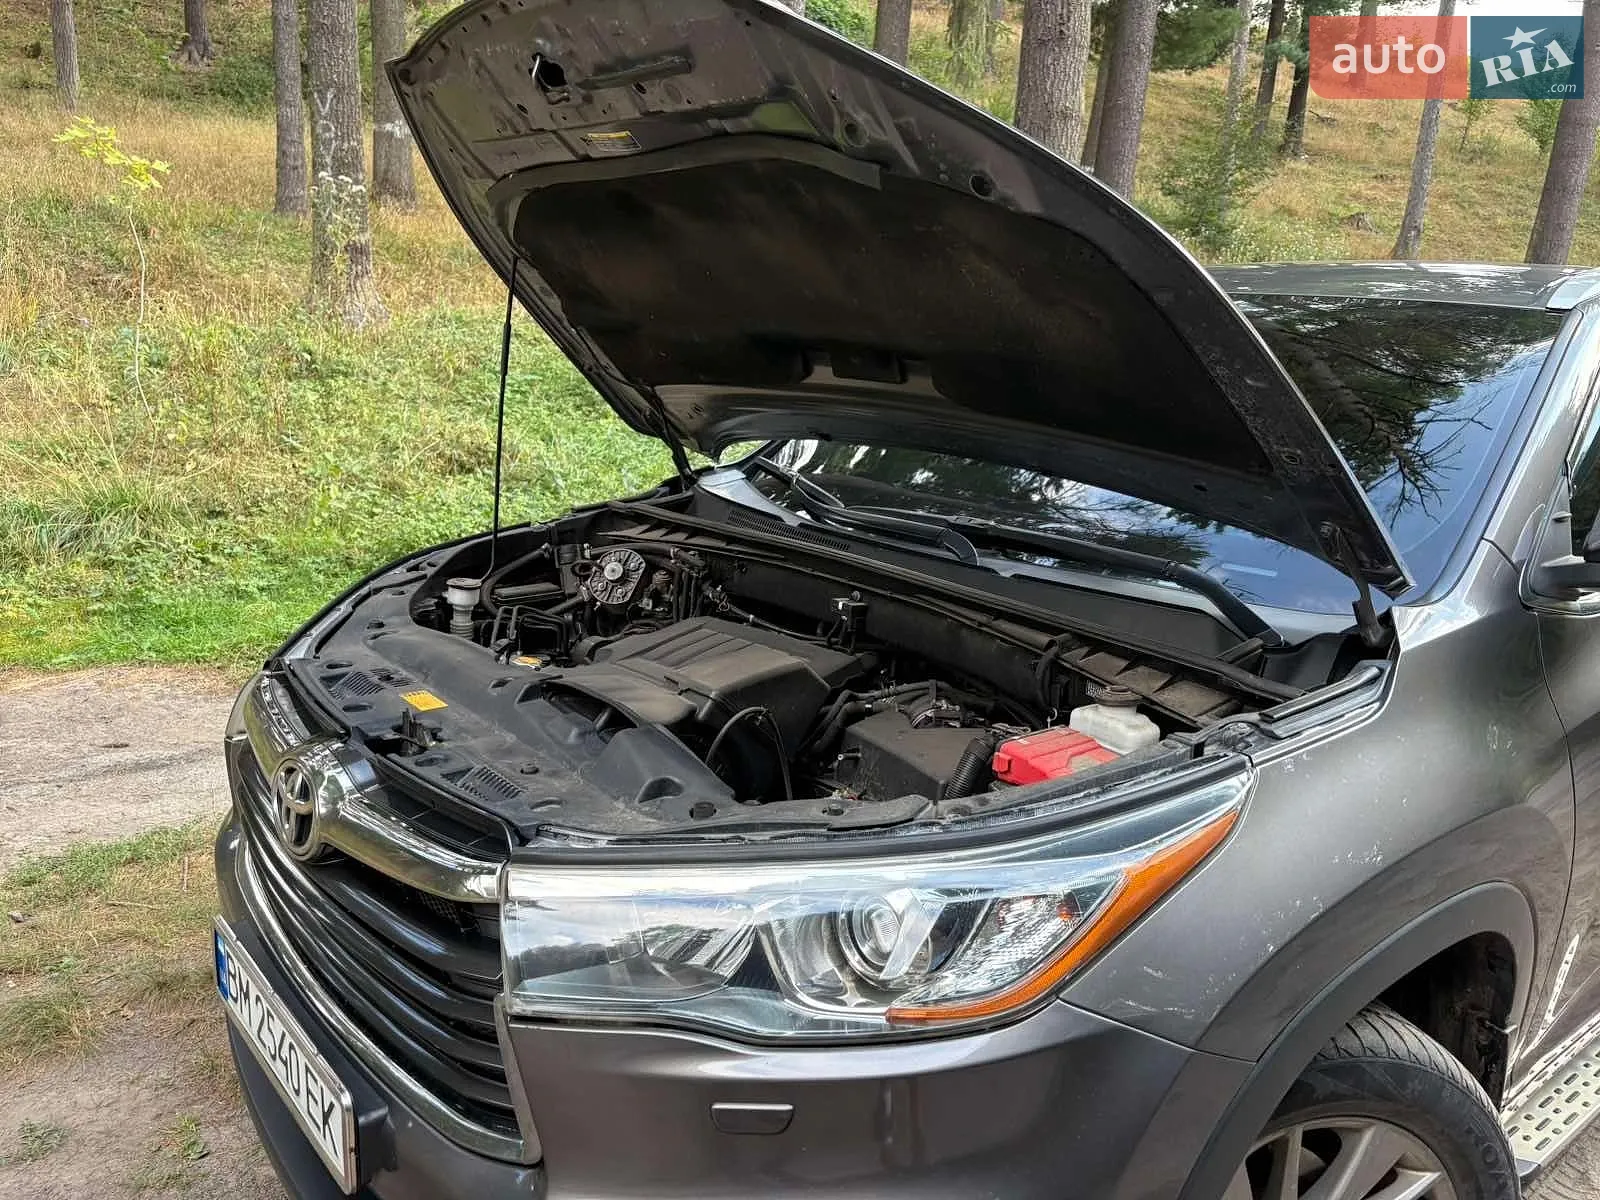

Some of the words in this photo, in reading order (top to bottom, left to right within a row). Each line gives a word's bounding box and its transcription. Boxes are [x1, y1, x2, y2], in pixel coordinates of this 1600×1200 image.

[228, 952, 251, 1026] BM
[256, 995, 301, 1097] 2540
[306, 1063, 338, 1158] EK
